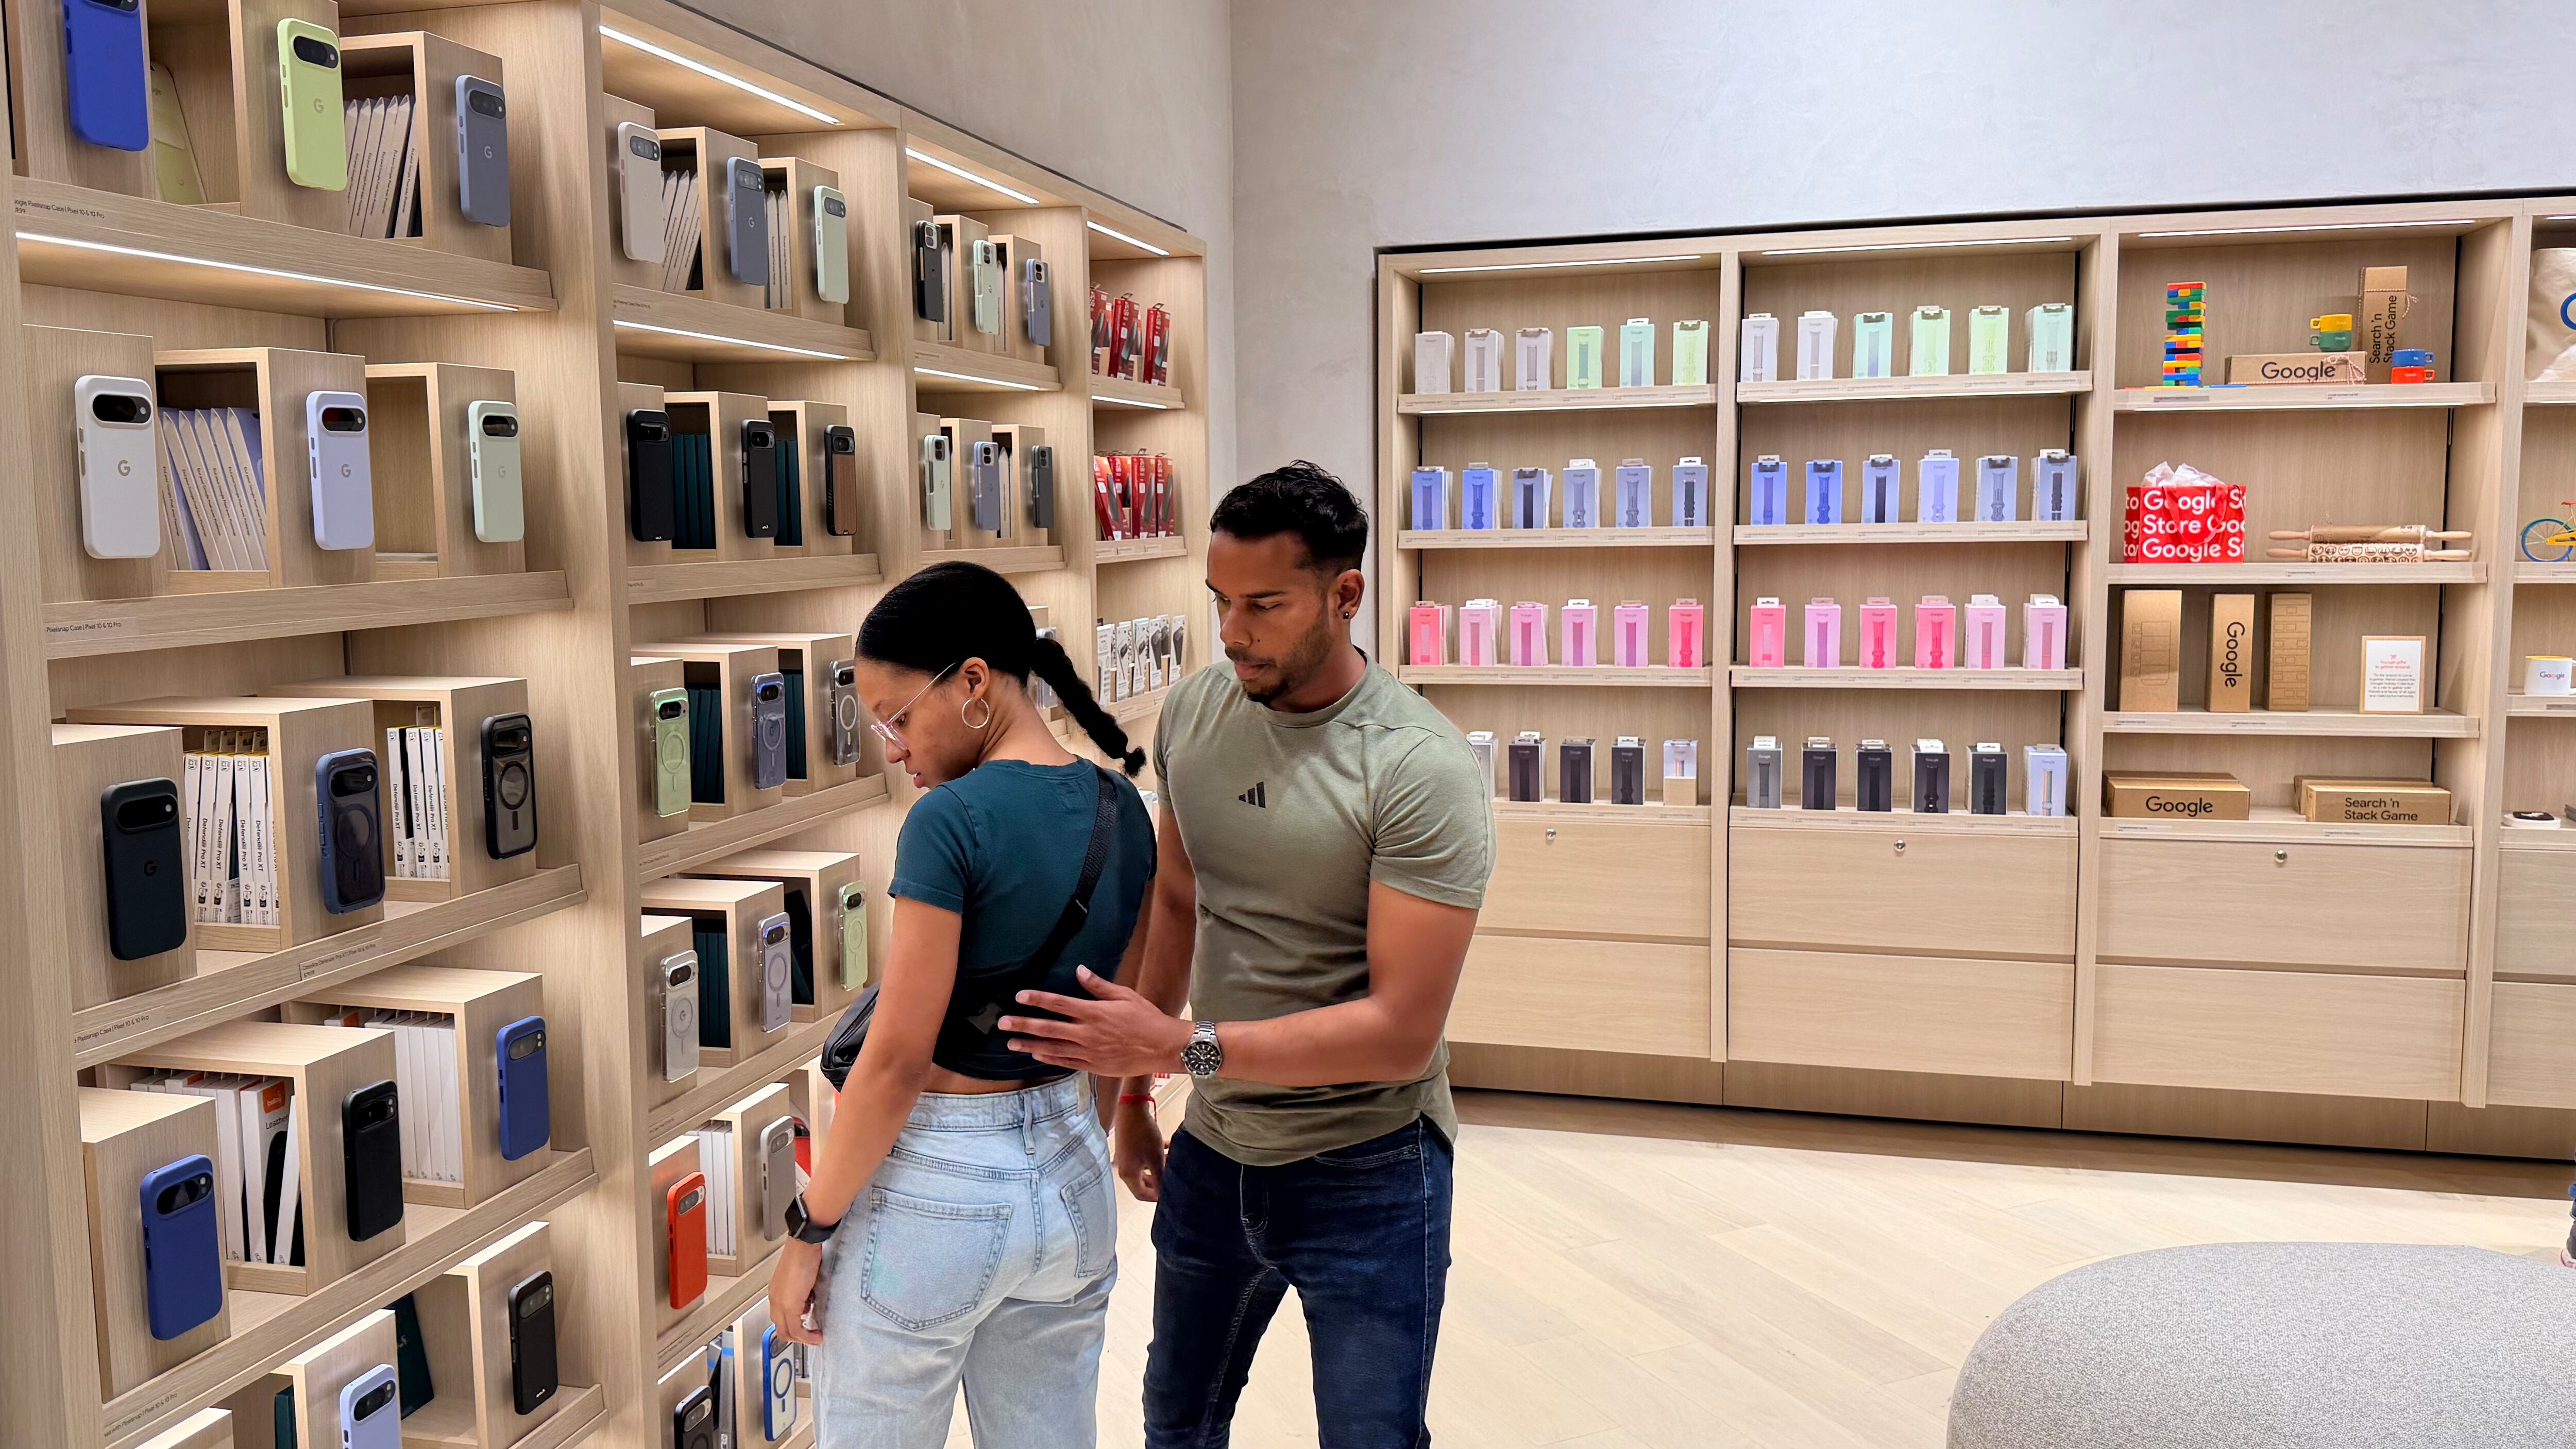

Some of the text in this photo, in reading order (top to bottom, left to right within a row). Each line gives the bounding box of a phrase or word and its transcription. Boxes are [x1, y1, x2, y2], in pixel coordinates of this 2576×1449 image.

[484, 145, 493, 159] G
[2383, 295, 2397, 363] Stack Game
[2369, 330, 2382, 364] Search
[2262, 361, 2336, 381] Google
[117, 459, 130, 476] G
[341, 464, 351, 478] G
[2220, 622, 2245, 688] Google
[2539, 671, 2565, 680] Google
[2146, 796, 2213, 816] Google
[2345, 797, 2387, 809] Search
[2344, 809, 2418, 822] Stack Game
[200, 860, 206, 868] XT
[216, 861, 221, 870] XT
